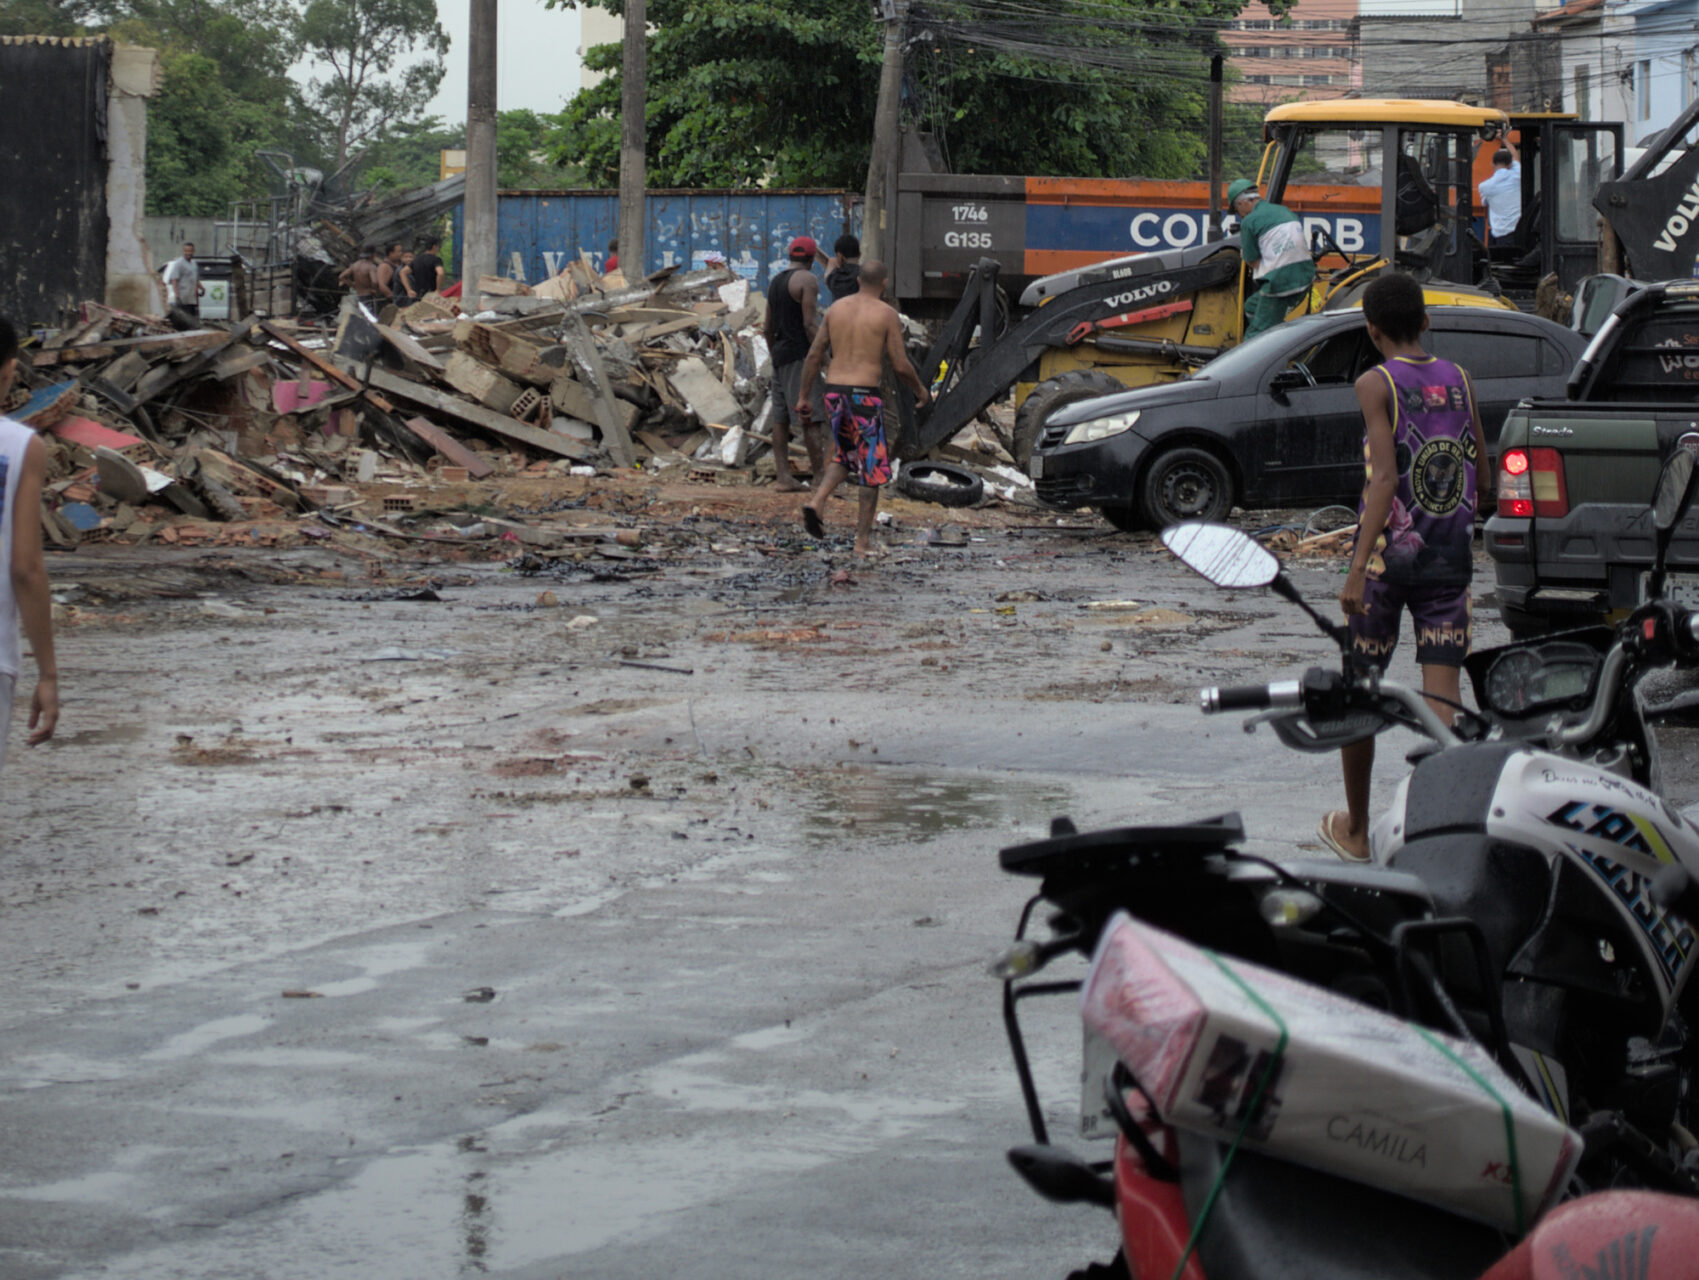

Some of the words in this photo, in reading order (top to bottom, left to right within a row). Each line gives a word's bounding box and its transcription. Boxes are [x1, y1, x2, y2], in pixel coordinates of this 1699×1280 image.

[952, 206, 989, 221] 1746
[1653, 173, 1699, 252] VOLV
[944, 231, 992, 249] G135
[1130, 212, 1365, 252] COMRB
[1104, 280, 1172, 309] VOLVO
[1327, 1115, 1428, 1168] CAMILA
